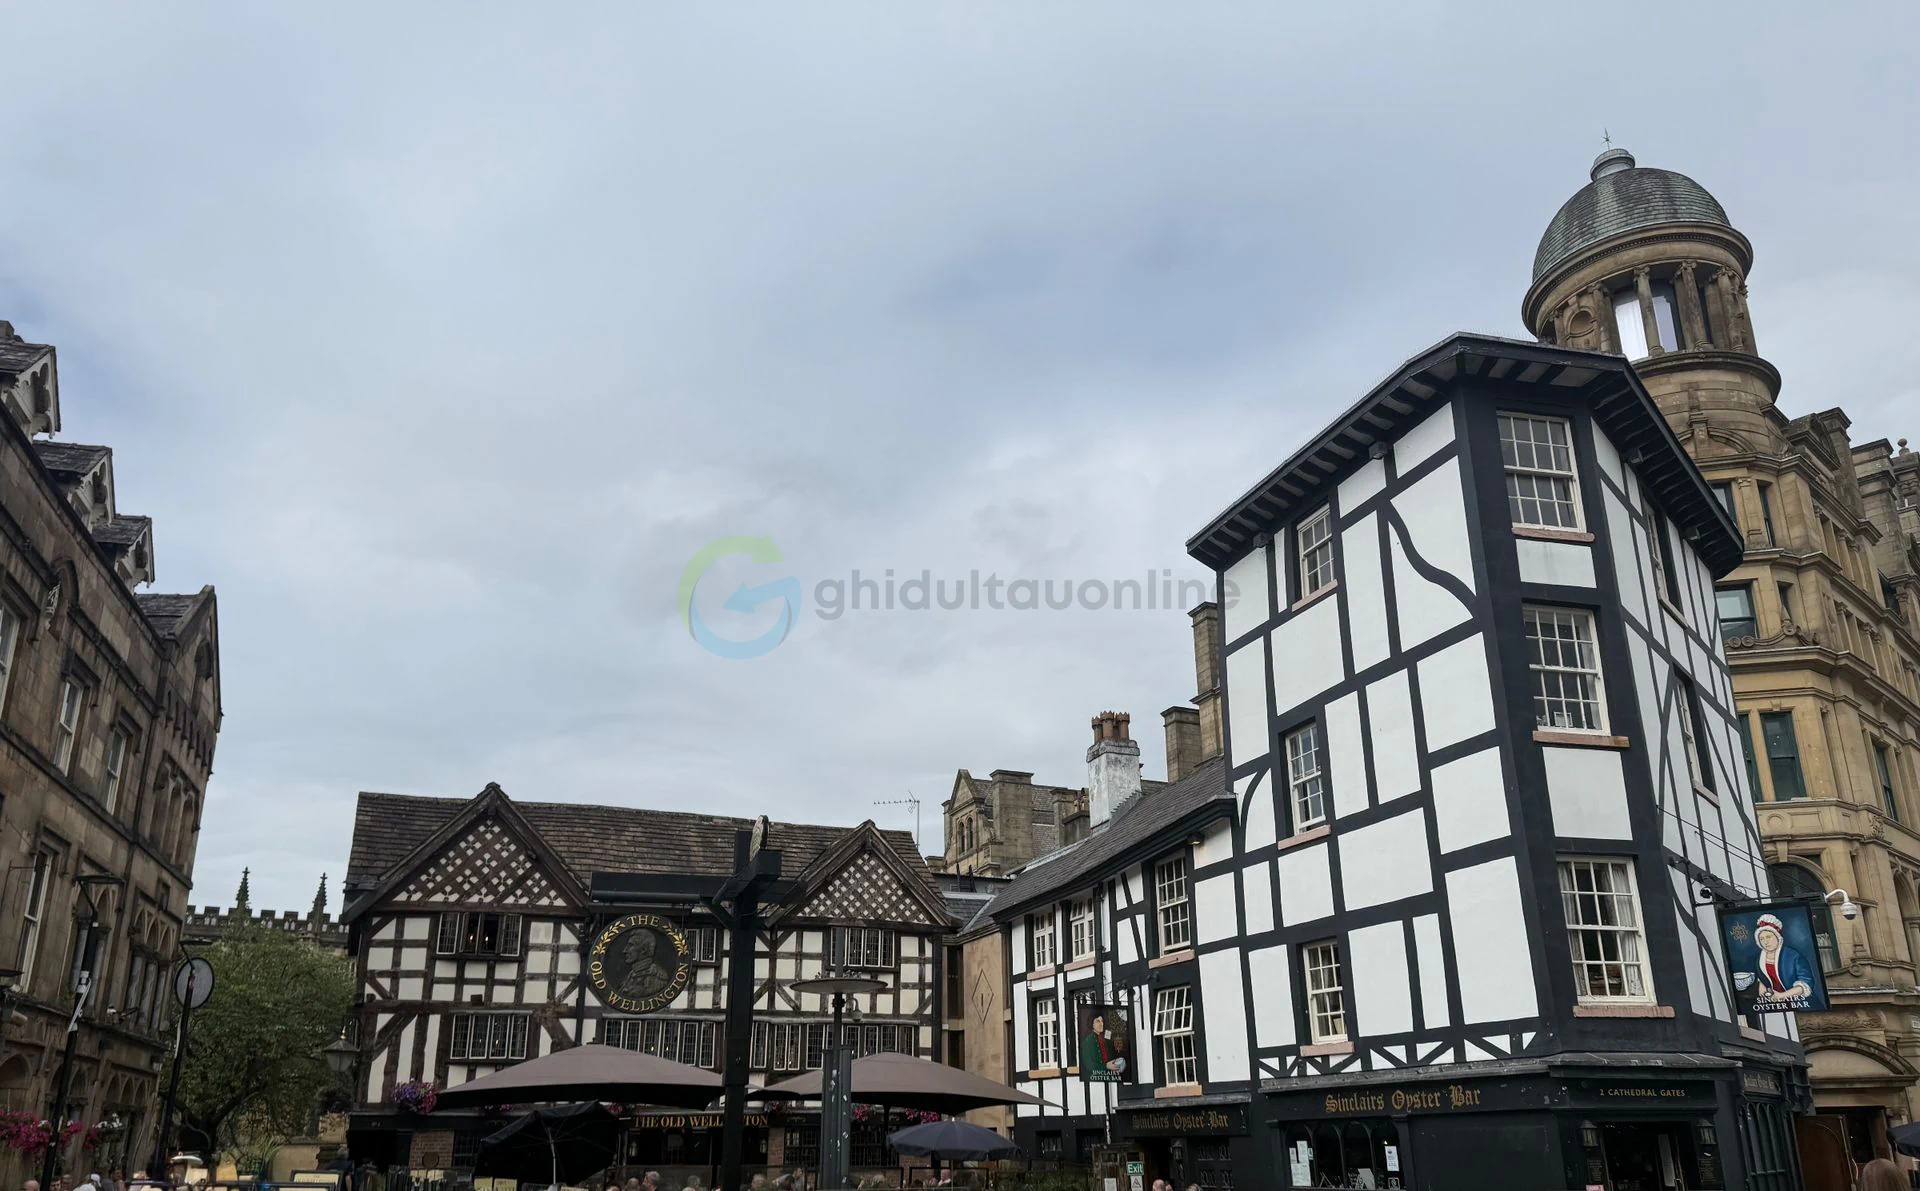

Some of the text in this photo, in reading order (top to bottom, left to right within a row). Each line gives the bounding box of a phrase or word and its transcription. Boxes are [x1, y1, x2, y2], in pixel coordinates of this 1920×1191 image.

[627, 914, 660, 927] THE
[590, 960, 689, 1012] OLD WELLINGTON
[1752, 1000, 1810, 1011] OYSTER BAR
[1325, 1084, 1481, 1113] Sinclairs Oyster Bar
[1607, 1088, 1658, 1097] CATHEDRAL
[1660, 1089, 1685, 1097] GATES
[634, 1114, 768, 1128] THE OLD WELLTON
[1173, 1111, 1206, 1132] Oyster
[1208, 1111, 1230, 1130] Bar
[1127, 1163, 1143, 1174] Exit
